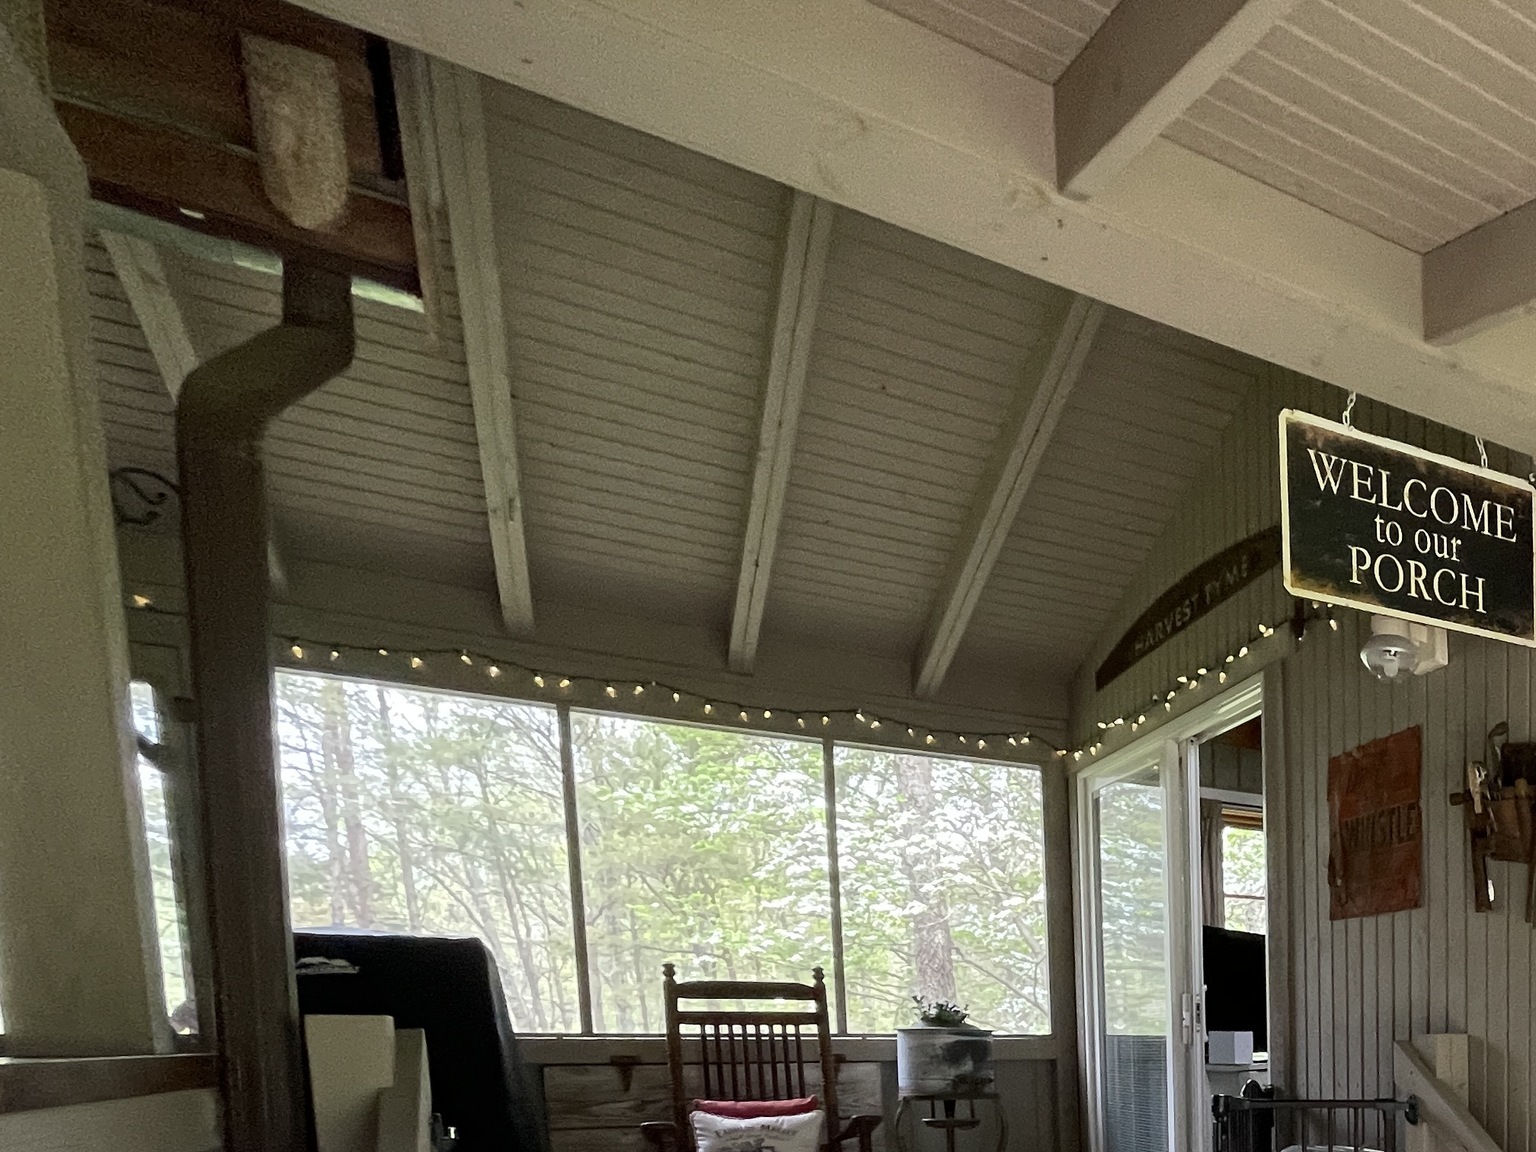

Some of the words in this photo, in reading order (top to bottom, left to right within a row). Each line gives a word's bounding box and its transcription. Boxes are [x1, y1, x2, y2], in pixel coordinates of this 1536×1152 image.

[1307, 448, 1517, 542] WELCOME
[1374, 513, 1403, 546] to
[1414, 528, 1462, 562] our
[1347, 544, 1487, 614] PORCH
